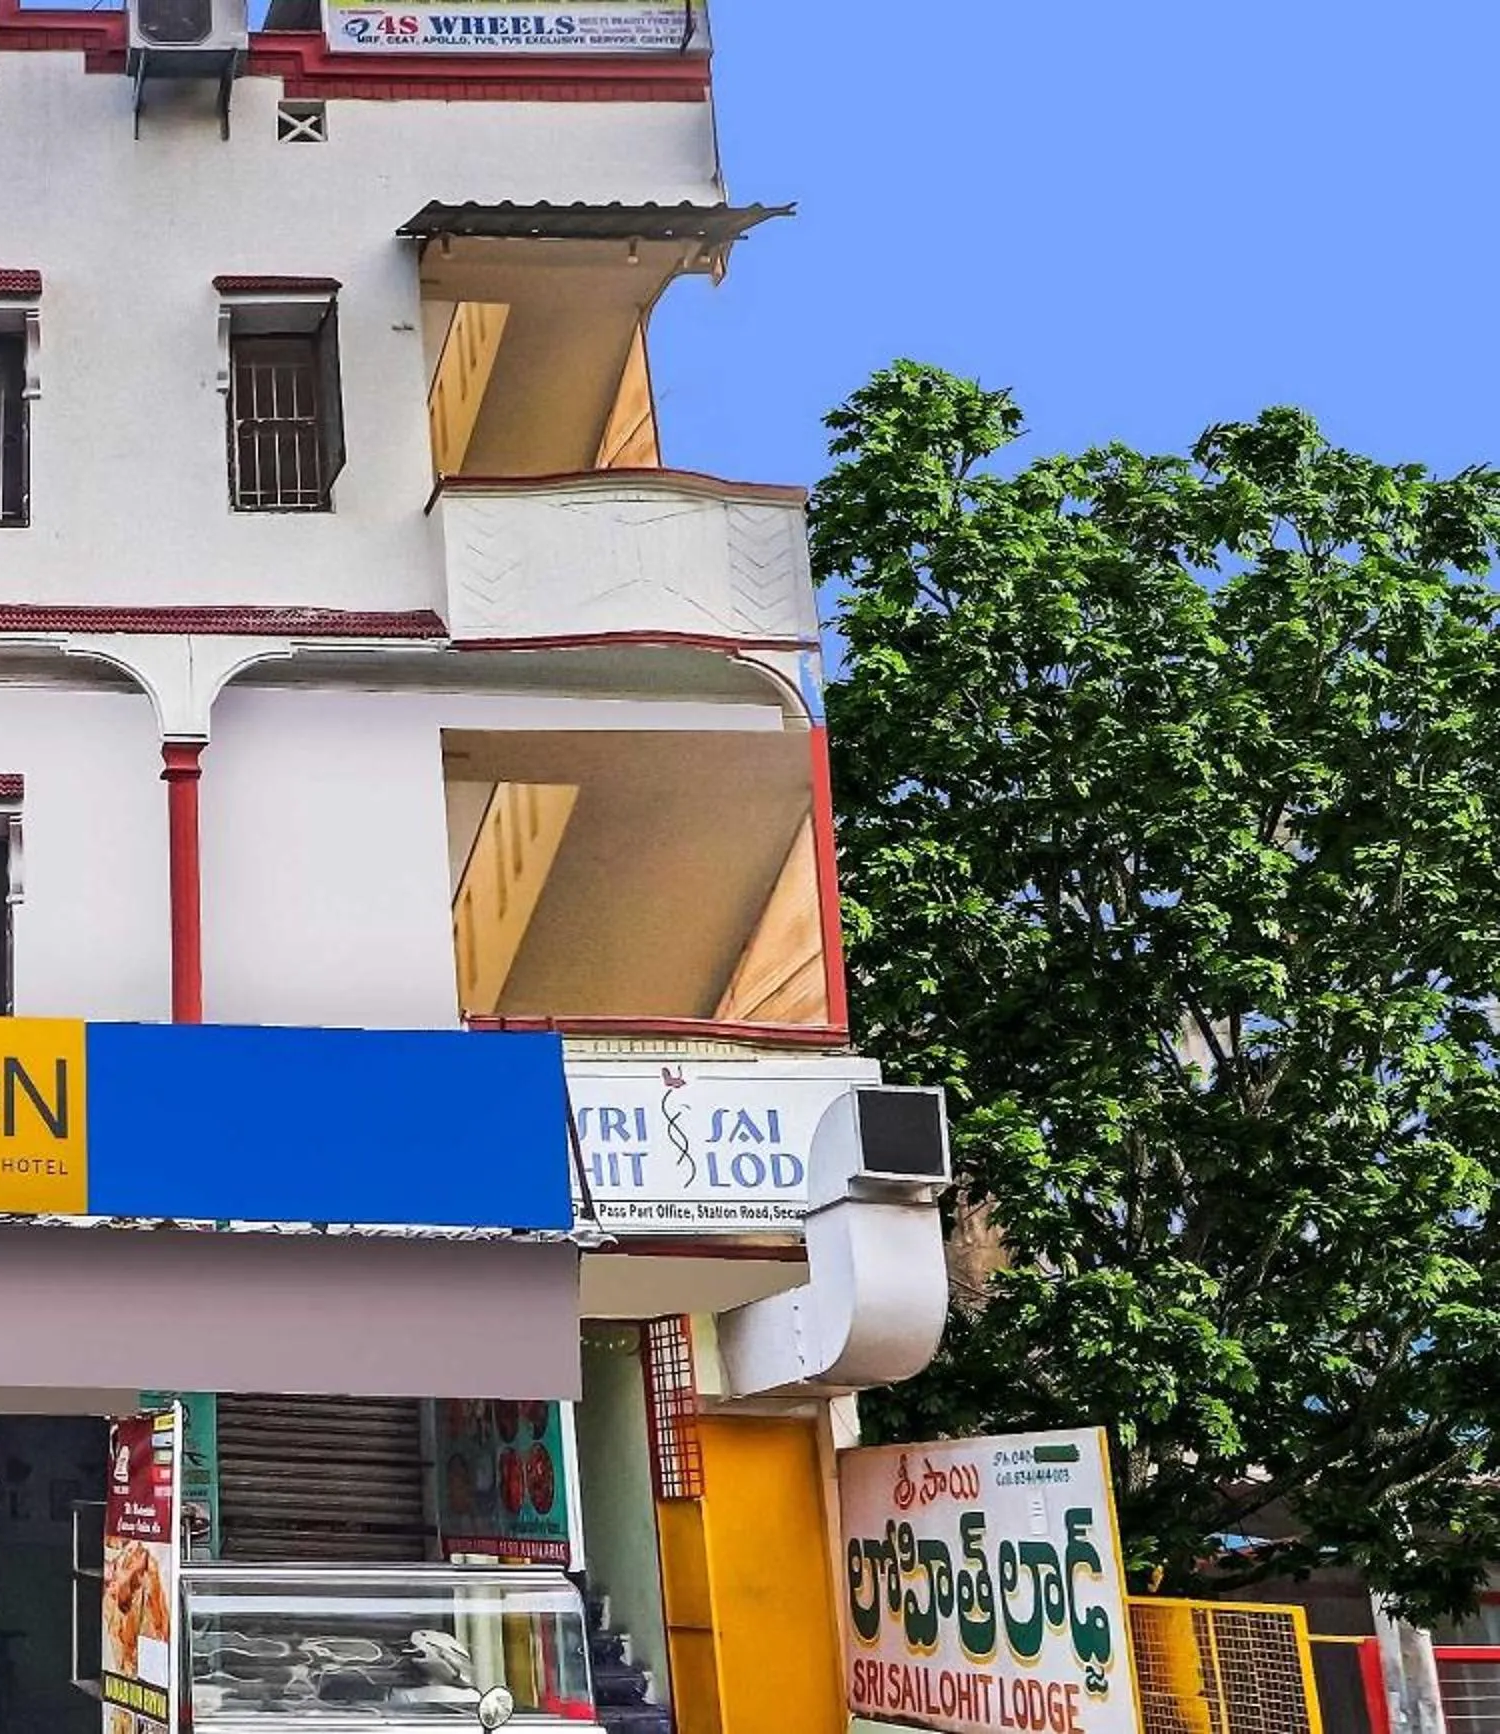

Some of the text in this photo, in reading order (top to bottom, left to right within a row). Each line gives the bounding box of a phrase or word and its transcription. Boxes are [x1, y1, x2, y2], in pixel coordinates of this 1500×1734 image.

[377, 14, 576, 35] 4S WHEELS
[525, 35, 586, 45] EXCLUSIVE
[589, 35, 638, 44] SERVICE
[577, 1106, 781, 1144] SRI SAI
[1, 1158, 69, 1175] HOTEL
[599, 1203, 627, 1218] Pass
[656, 1204, 695, 1223] Office,
[697, 1204, 738, 1220] Station
[853, 1658, 1085, 1734] SRI SAI LOHIT LODGE
